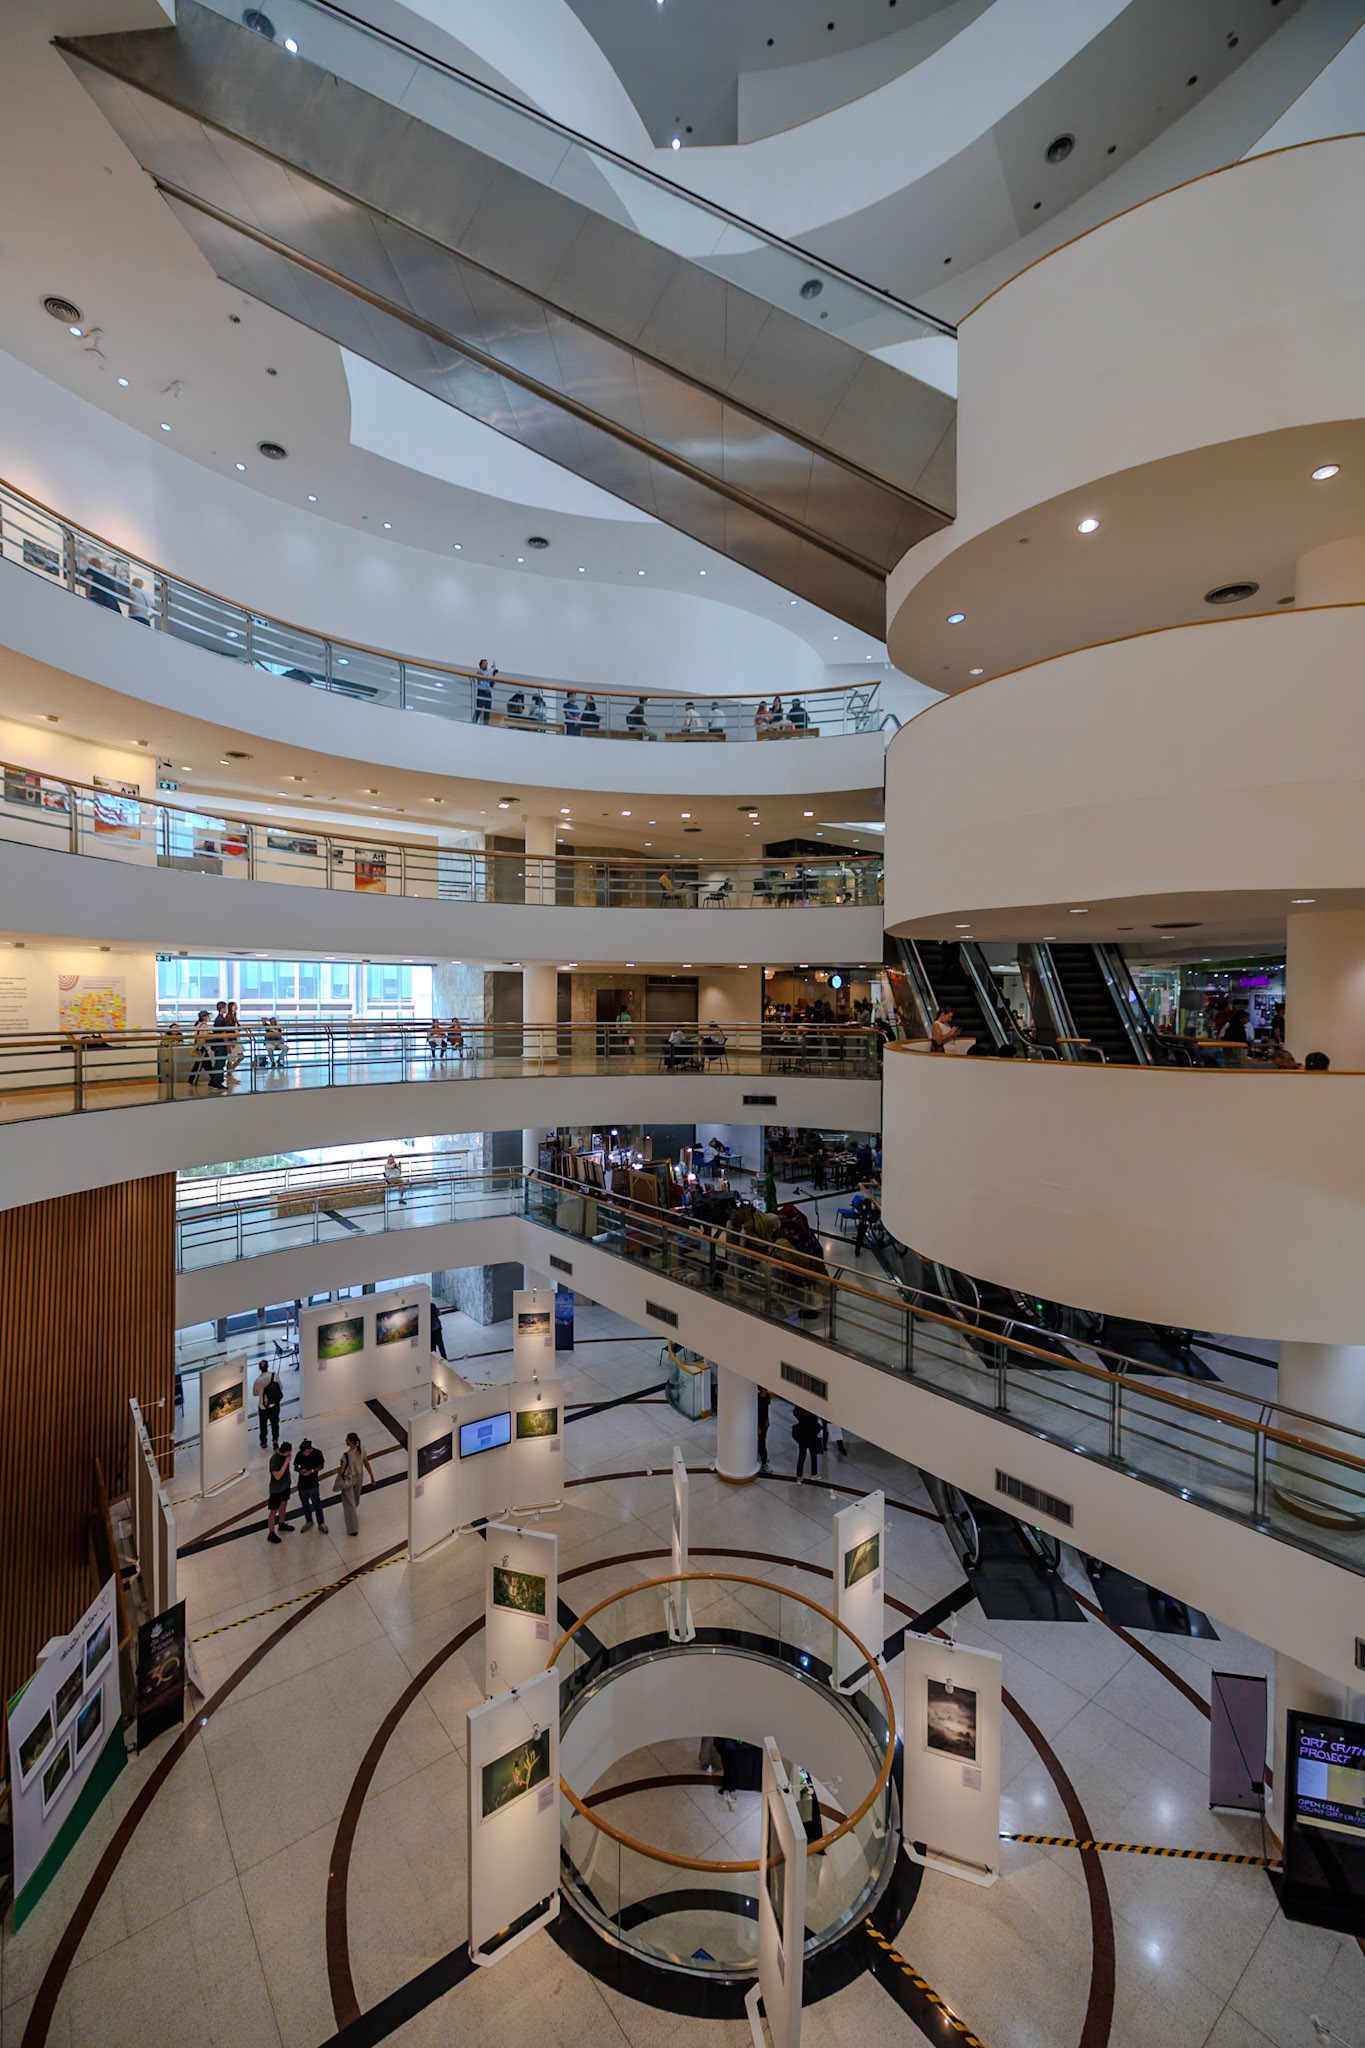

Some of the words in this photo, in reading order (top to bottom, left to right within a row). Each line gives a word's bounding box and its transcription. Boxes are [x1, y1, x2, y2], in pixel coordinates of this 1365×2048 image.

[372, 853, 385, 861] Art
[1300, 1736, 1328, 1749] ART
[1299, 1747, 1351, 1764] PROJECT
[1298, 1798, 1321, 1809] OPEN
